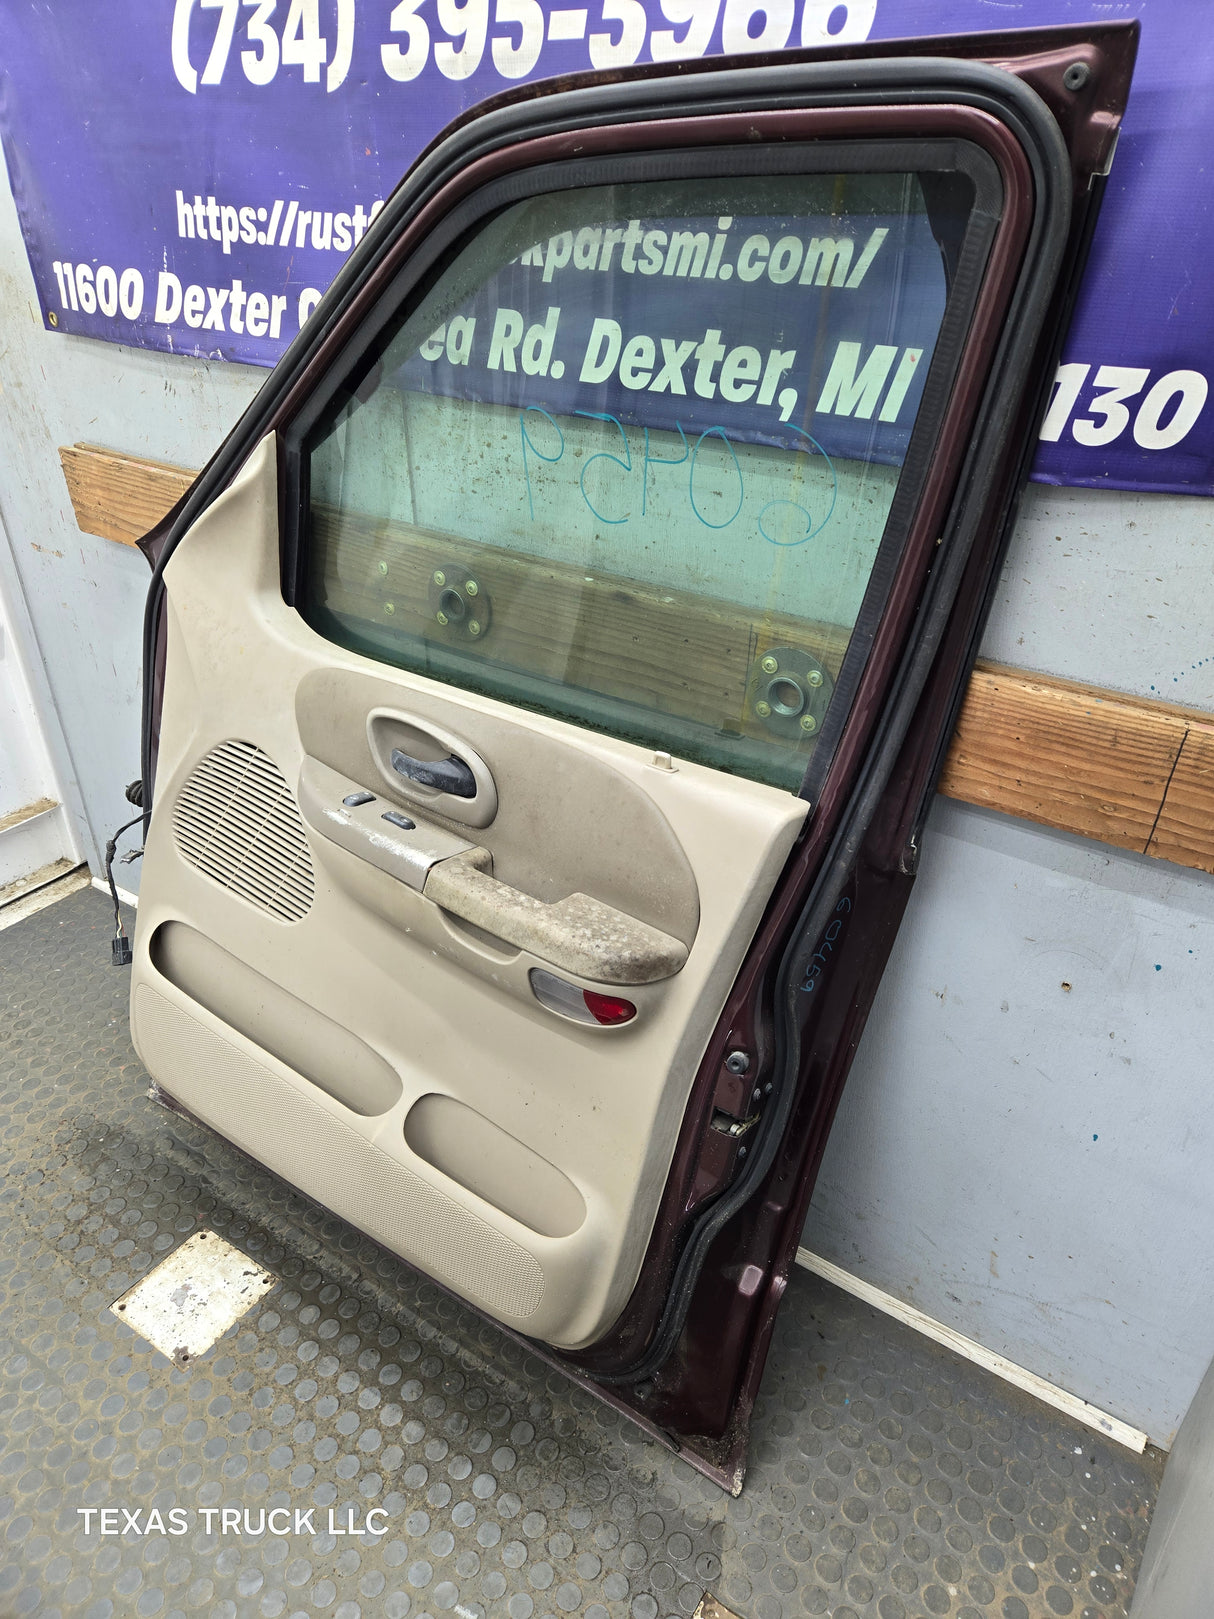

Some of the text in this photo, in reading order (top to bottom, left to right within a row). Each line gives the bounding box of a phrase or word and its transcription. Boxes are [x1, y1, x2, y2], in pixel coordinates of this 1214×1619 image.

[171, 0, 356, 94] (734)
[52, 260, 145, 321] 11600
[154, 271, 287, 339] Dexter
[487, 306, 566, 379] Rd.
[578, 317, 798, 422] Dexter,
[815, 340, 924, 423] MI
[1038, 362, 1209, 451] 130
